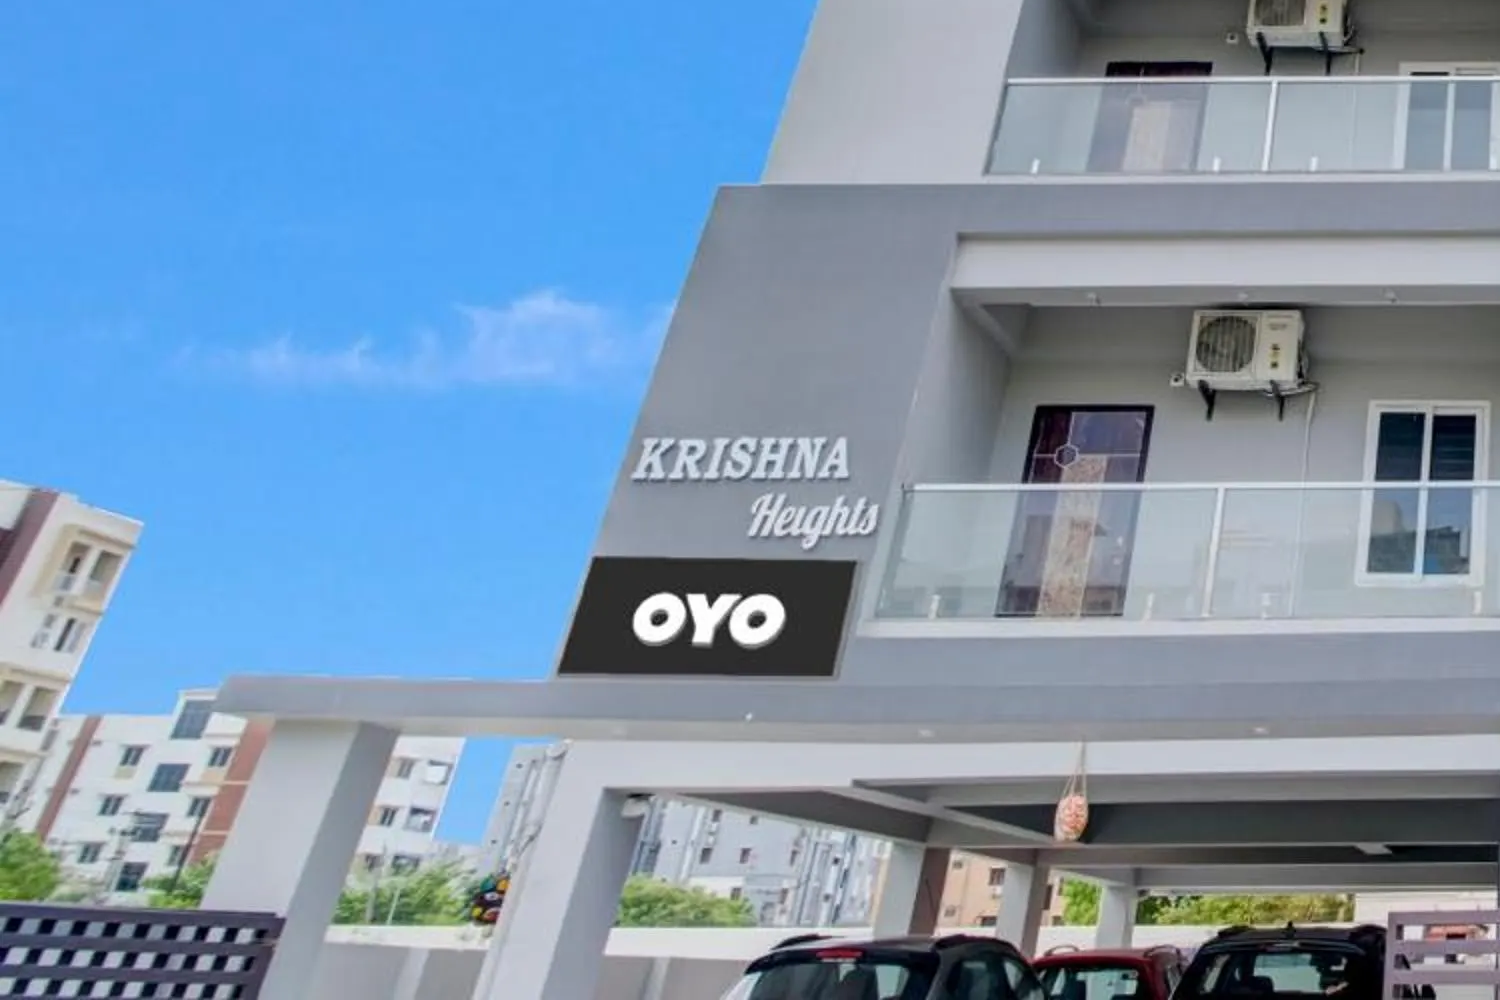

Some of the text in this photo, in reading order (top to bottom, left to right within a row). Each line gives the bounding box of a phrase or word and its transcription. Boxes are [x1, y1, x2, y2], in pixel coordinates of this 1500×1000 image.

[631, 436, 850, 481] KRISHNA
[748, 493, 880, 549] Heights
[632, 592, 787, 648] OYO
